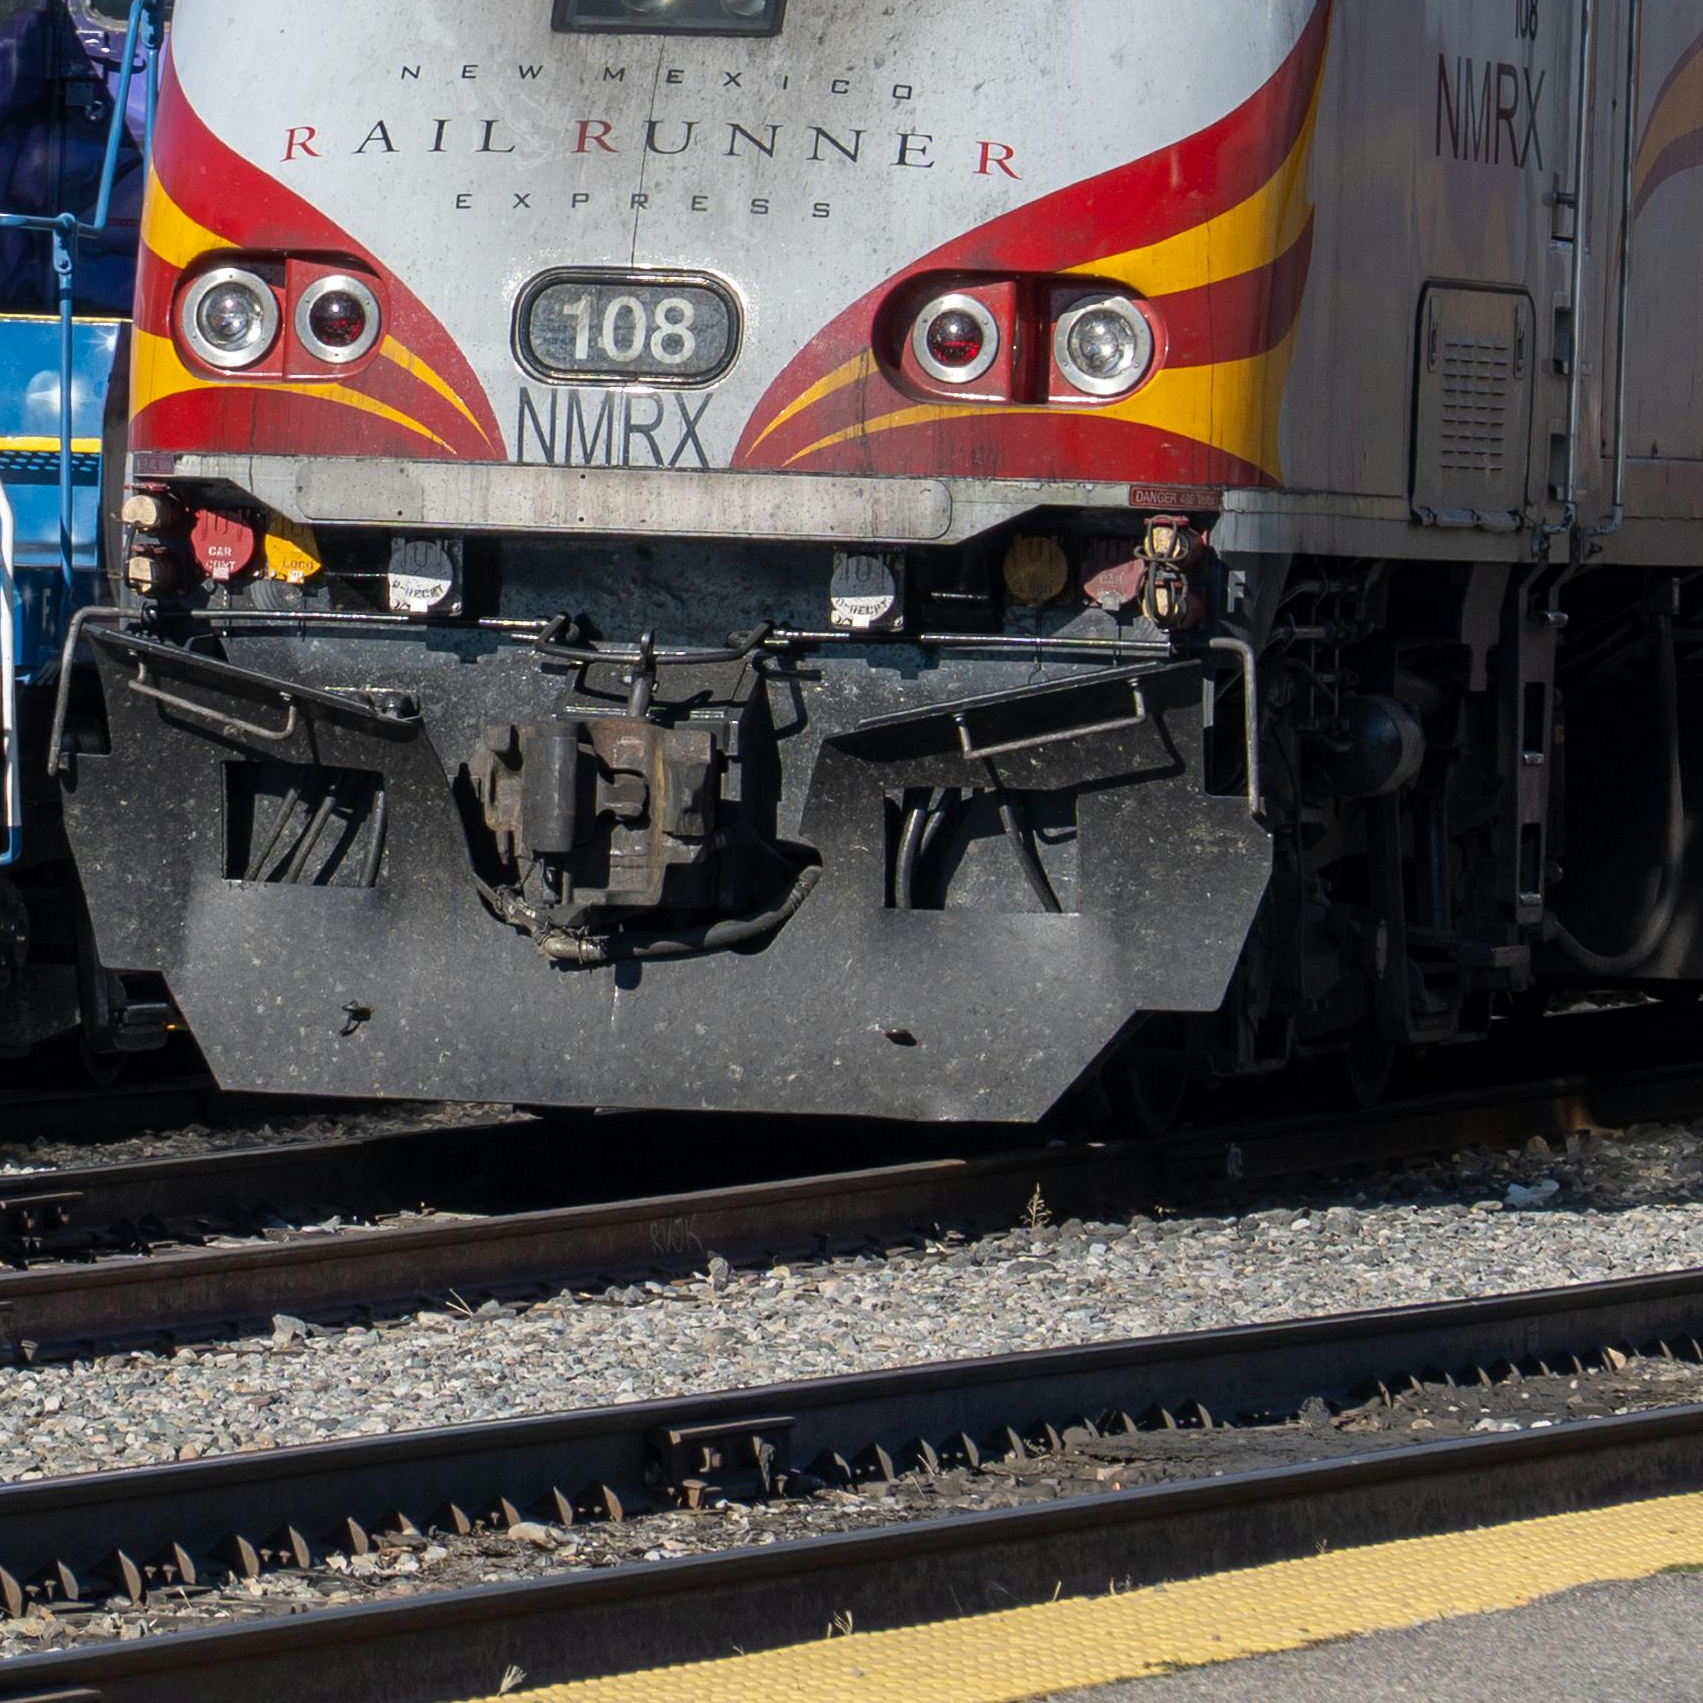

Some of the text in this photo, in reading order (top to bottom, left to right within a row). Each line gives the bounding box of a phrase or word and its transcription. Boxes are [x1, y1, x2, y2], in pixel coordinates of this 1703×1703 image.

[401, 63, 913, 100] NEW MEXICO
[1435, 53, 1545, 171] NMRX
[281, 119, 1021, 180] RAIL RUNNER
[456, 193, 830, 220] EXPRESS
[563, 294, 697, 364] 108
[518, 387, 710, 468] NMRX
[1136, 490, 1177, 505] DANGER
[208, 546, 232, 557] CAR
